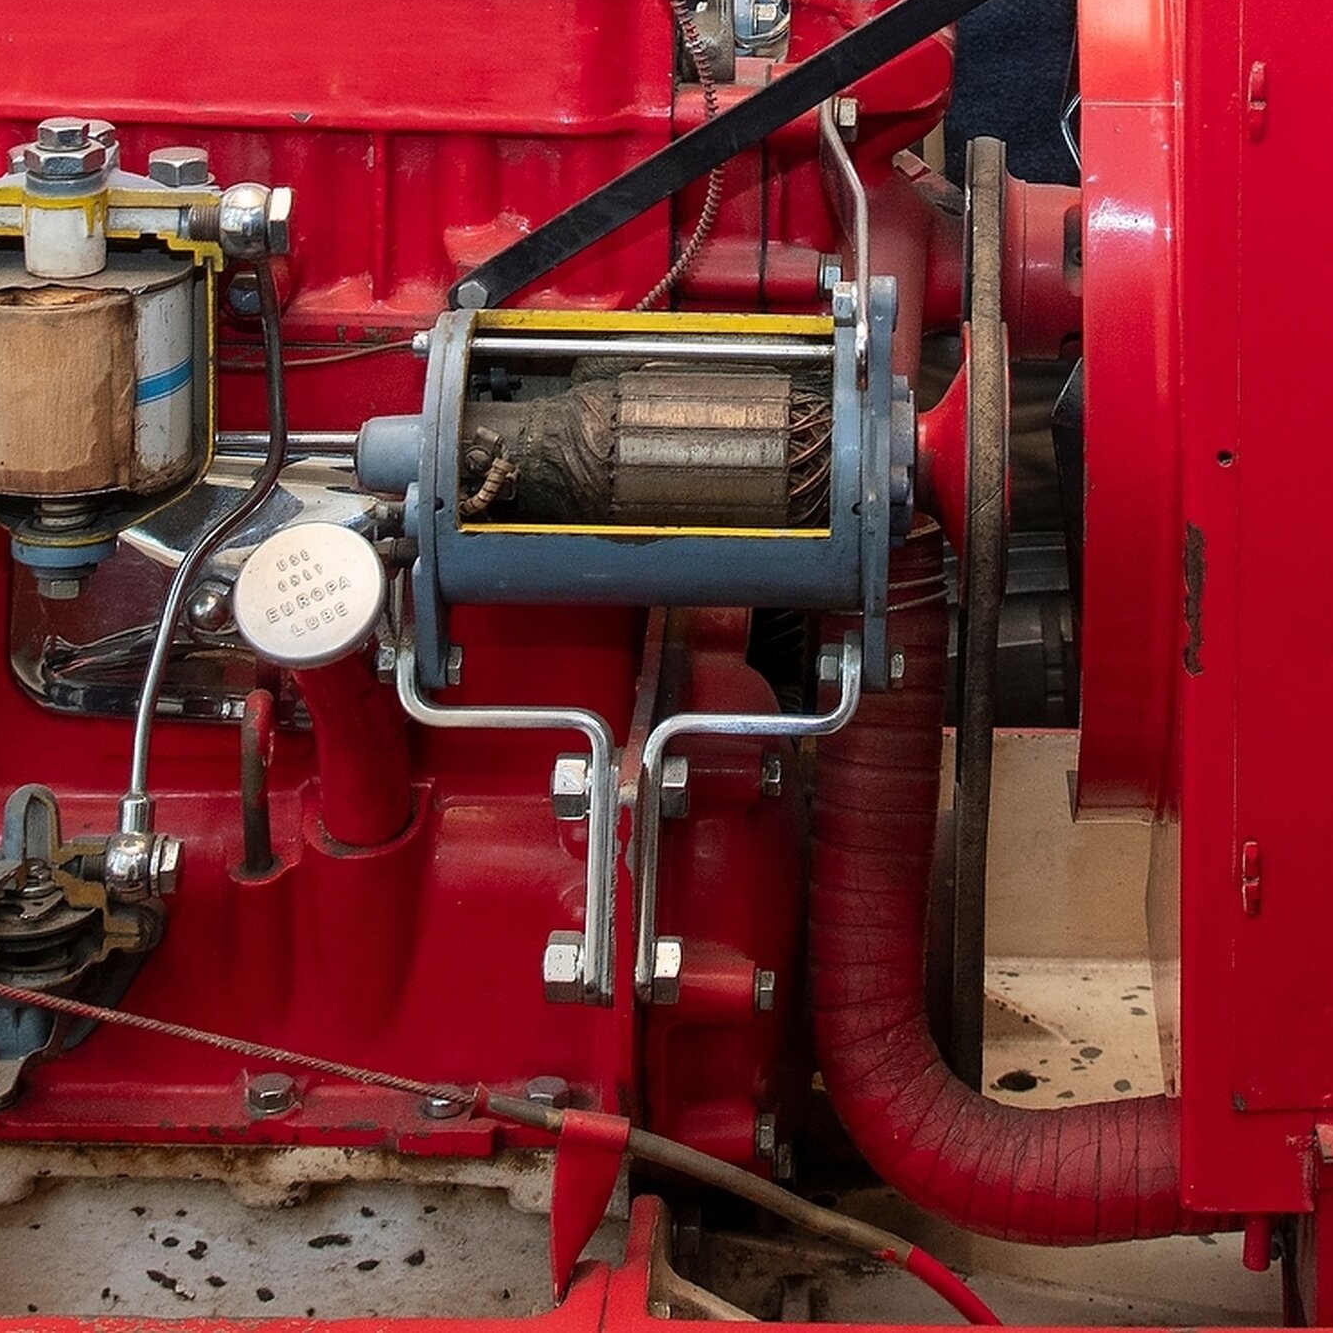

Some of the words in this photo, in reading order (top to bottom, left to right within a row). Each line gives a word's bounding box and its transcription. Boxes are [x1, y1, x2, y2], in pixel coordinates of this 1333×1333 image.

[275, 548, 311, 573] USE
[265, 575, 352, 625] EUROPA
[290, 601, 349, 638] LUBE
